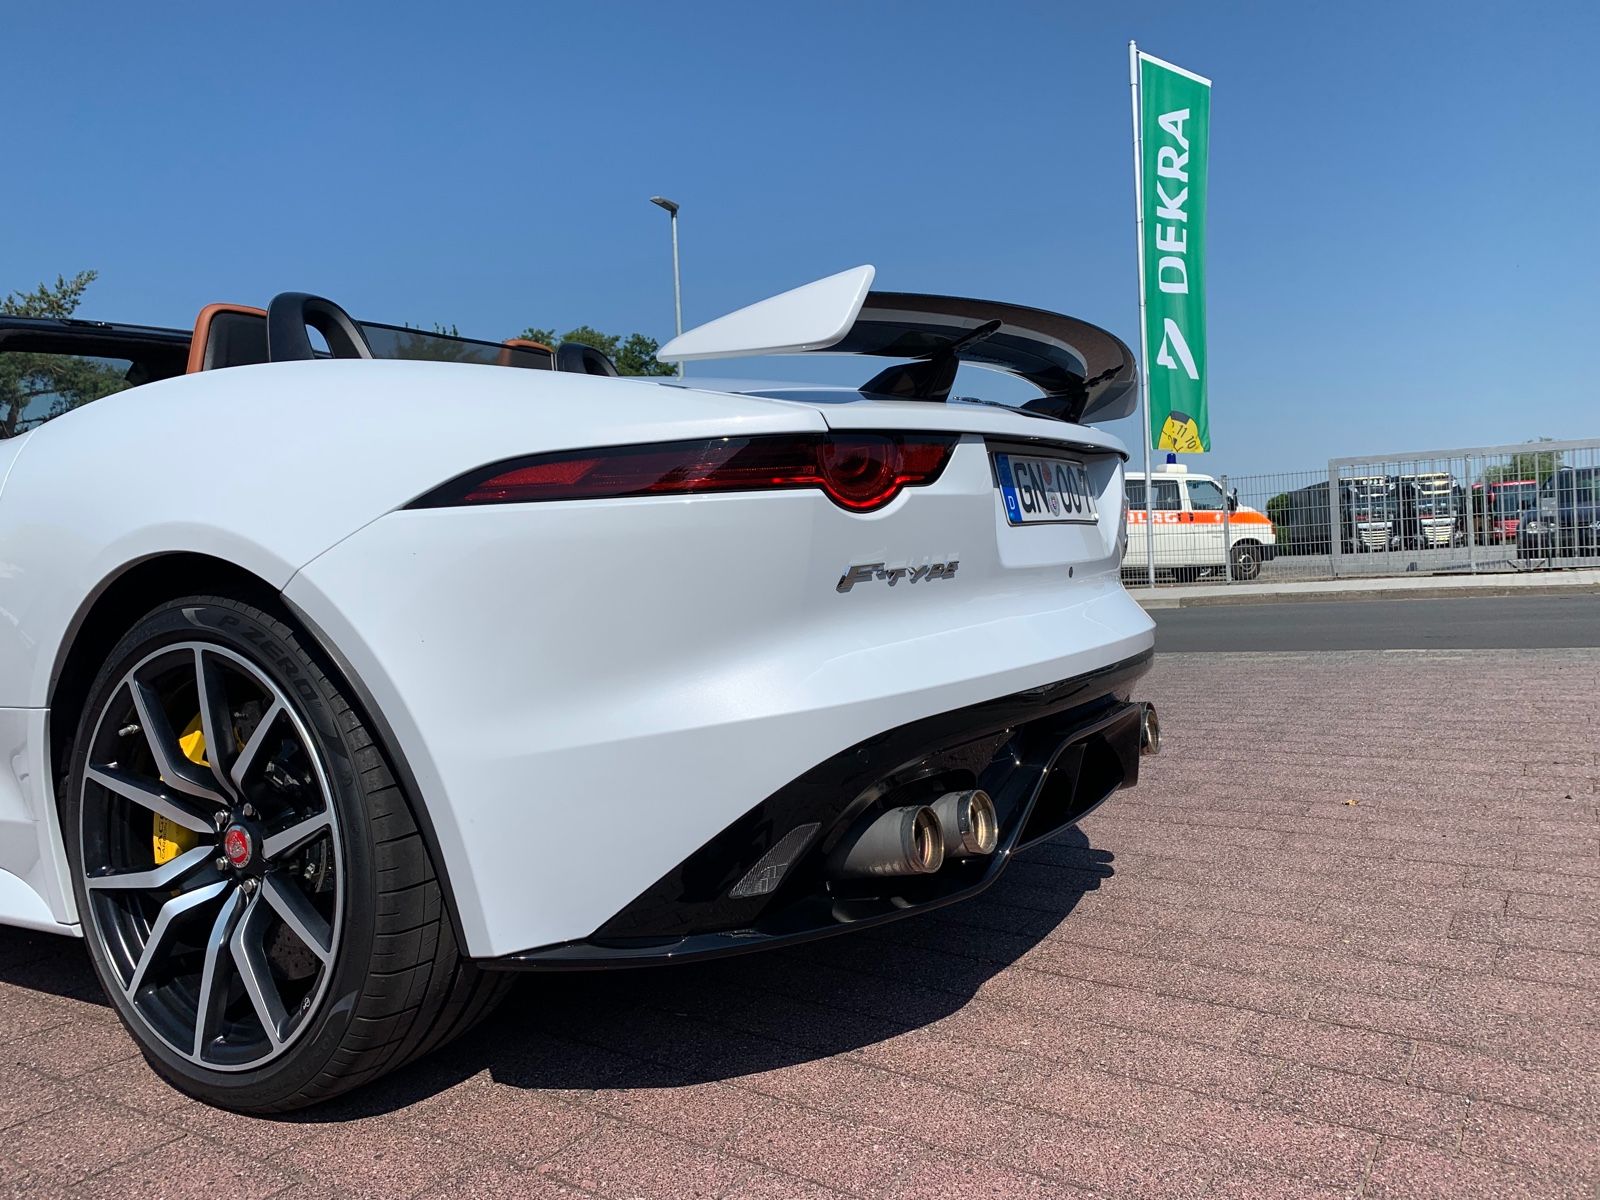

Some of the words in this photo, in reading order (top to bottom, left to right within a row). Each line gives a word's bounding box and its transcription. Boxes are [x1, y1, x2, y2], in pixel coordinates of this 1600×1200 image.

[1156, 108, 1190, 295] DEKRA
[1008, 495, 1016, 510] D
[1014, 462, 1050, 514] GN
[836, 561, 960, 593] F-TYPE
